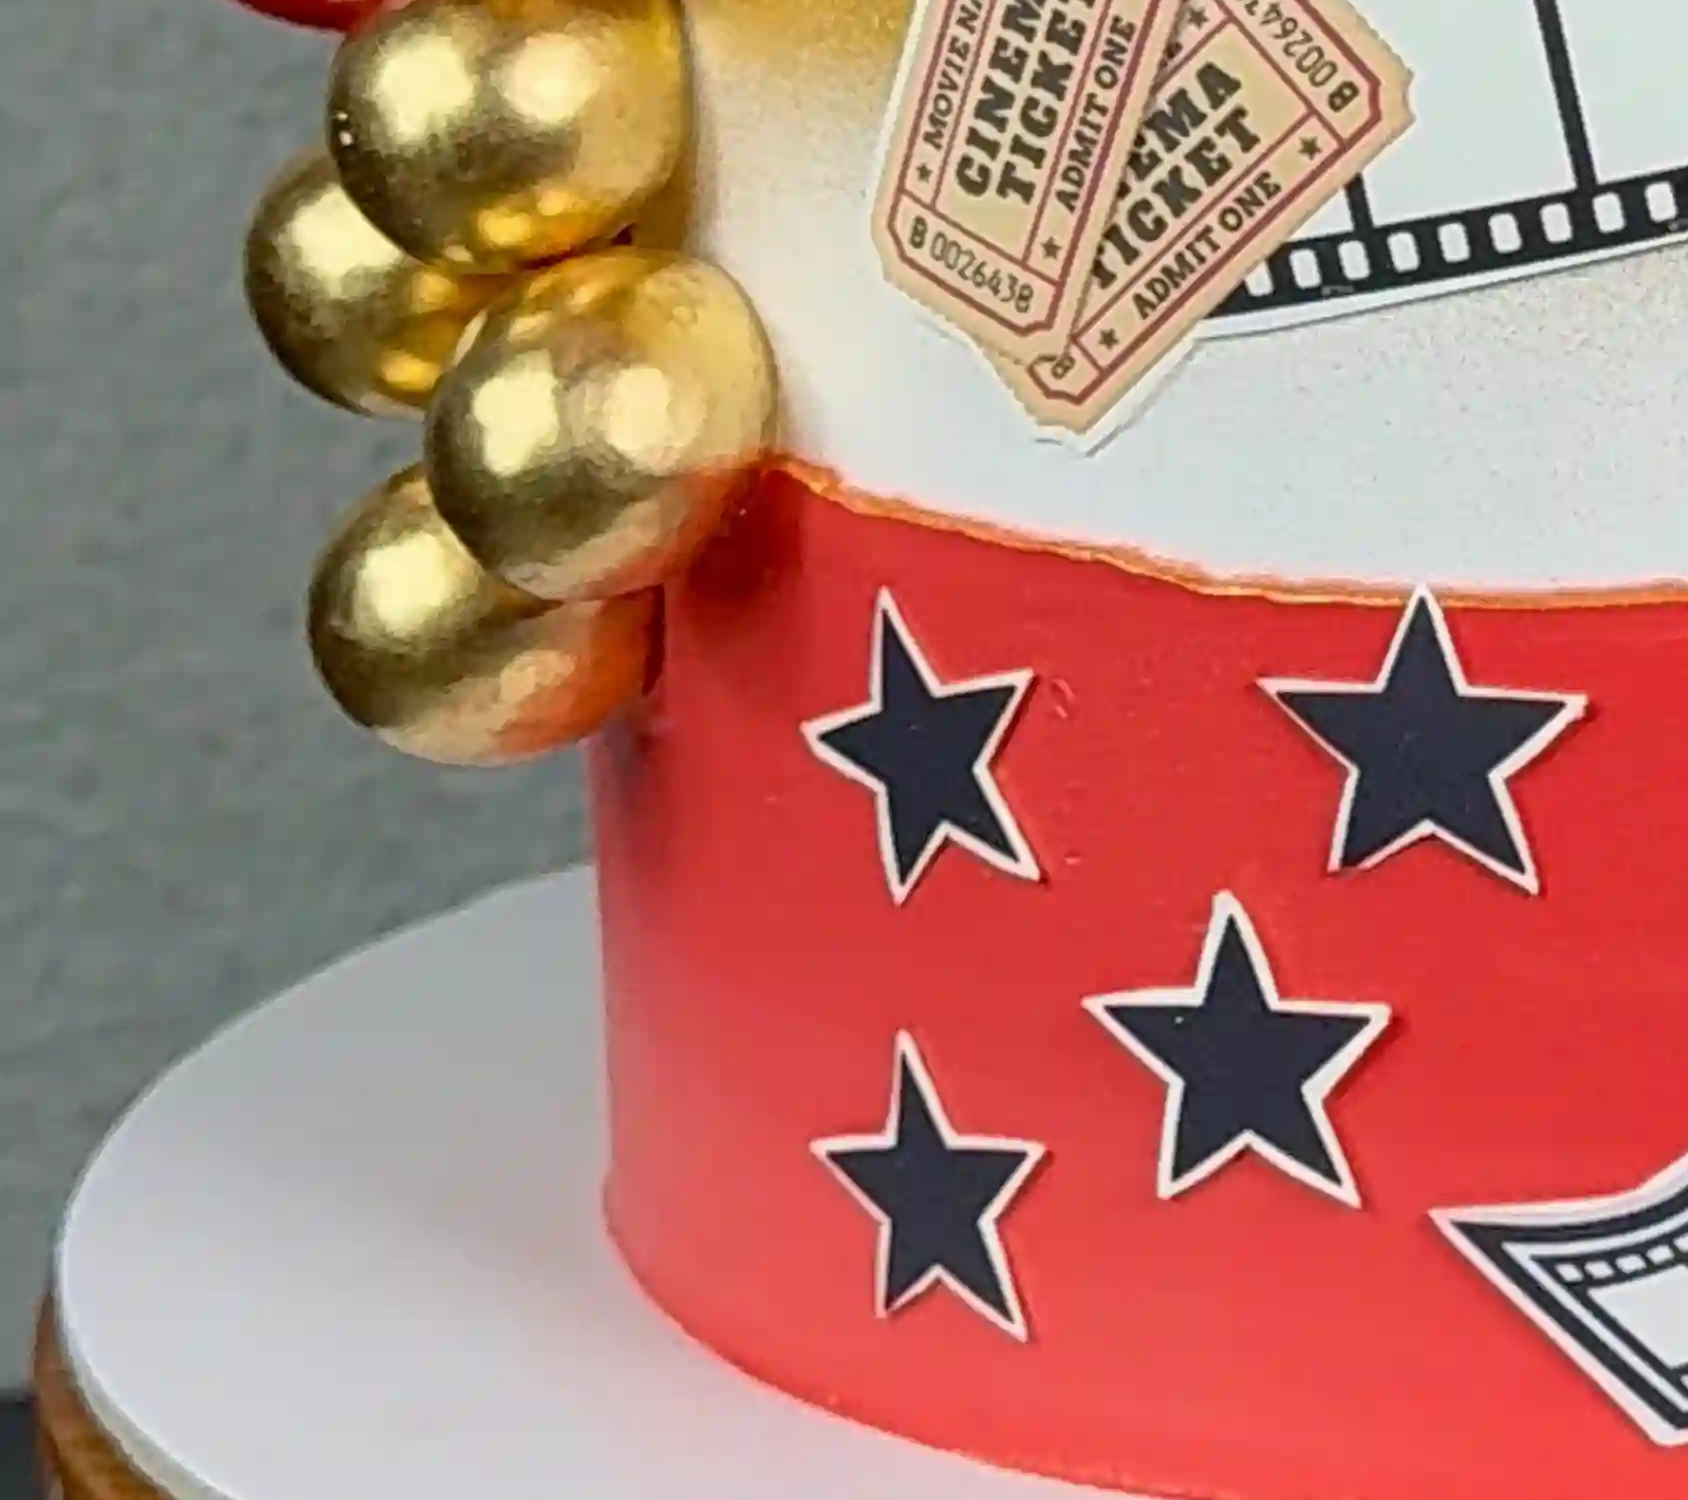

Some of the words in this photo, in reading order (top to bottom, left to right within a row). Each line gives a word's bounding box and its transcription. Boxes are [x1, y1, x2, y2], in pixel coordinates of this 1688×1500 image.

[923, 36, 971, 151] MOVIE
[1055, 92, 1109, 214] ADMIT
[1094, 14, 1136, 90] ONE
[1117, 62, 1242, 198] EMA
[1131, 225, 1221, 320] ADMIT
[1218, 171, 1281, 232] ONE
